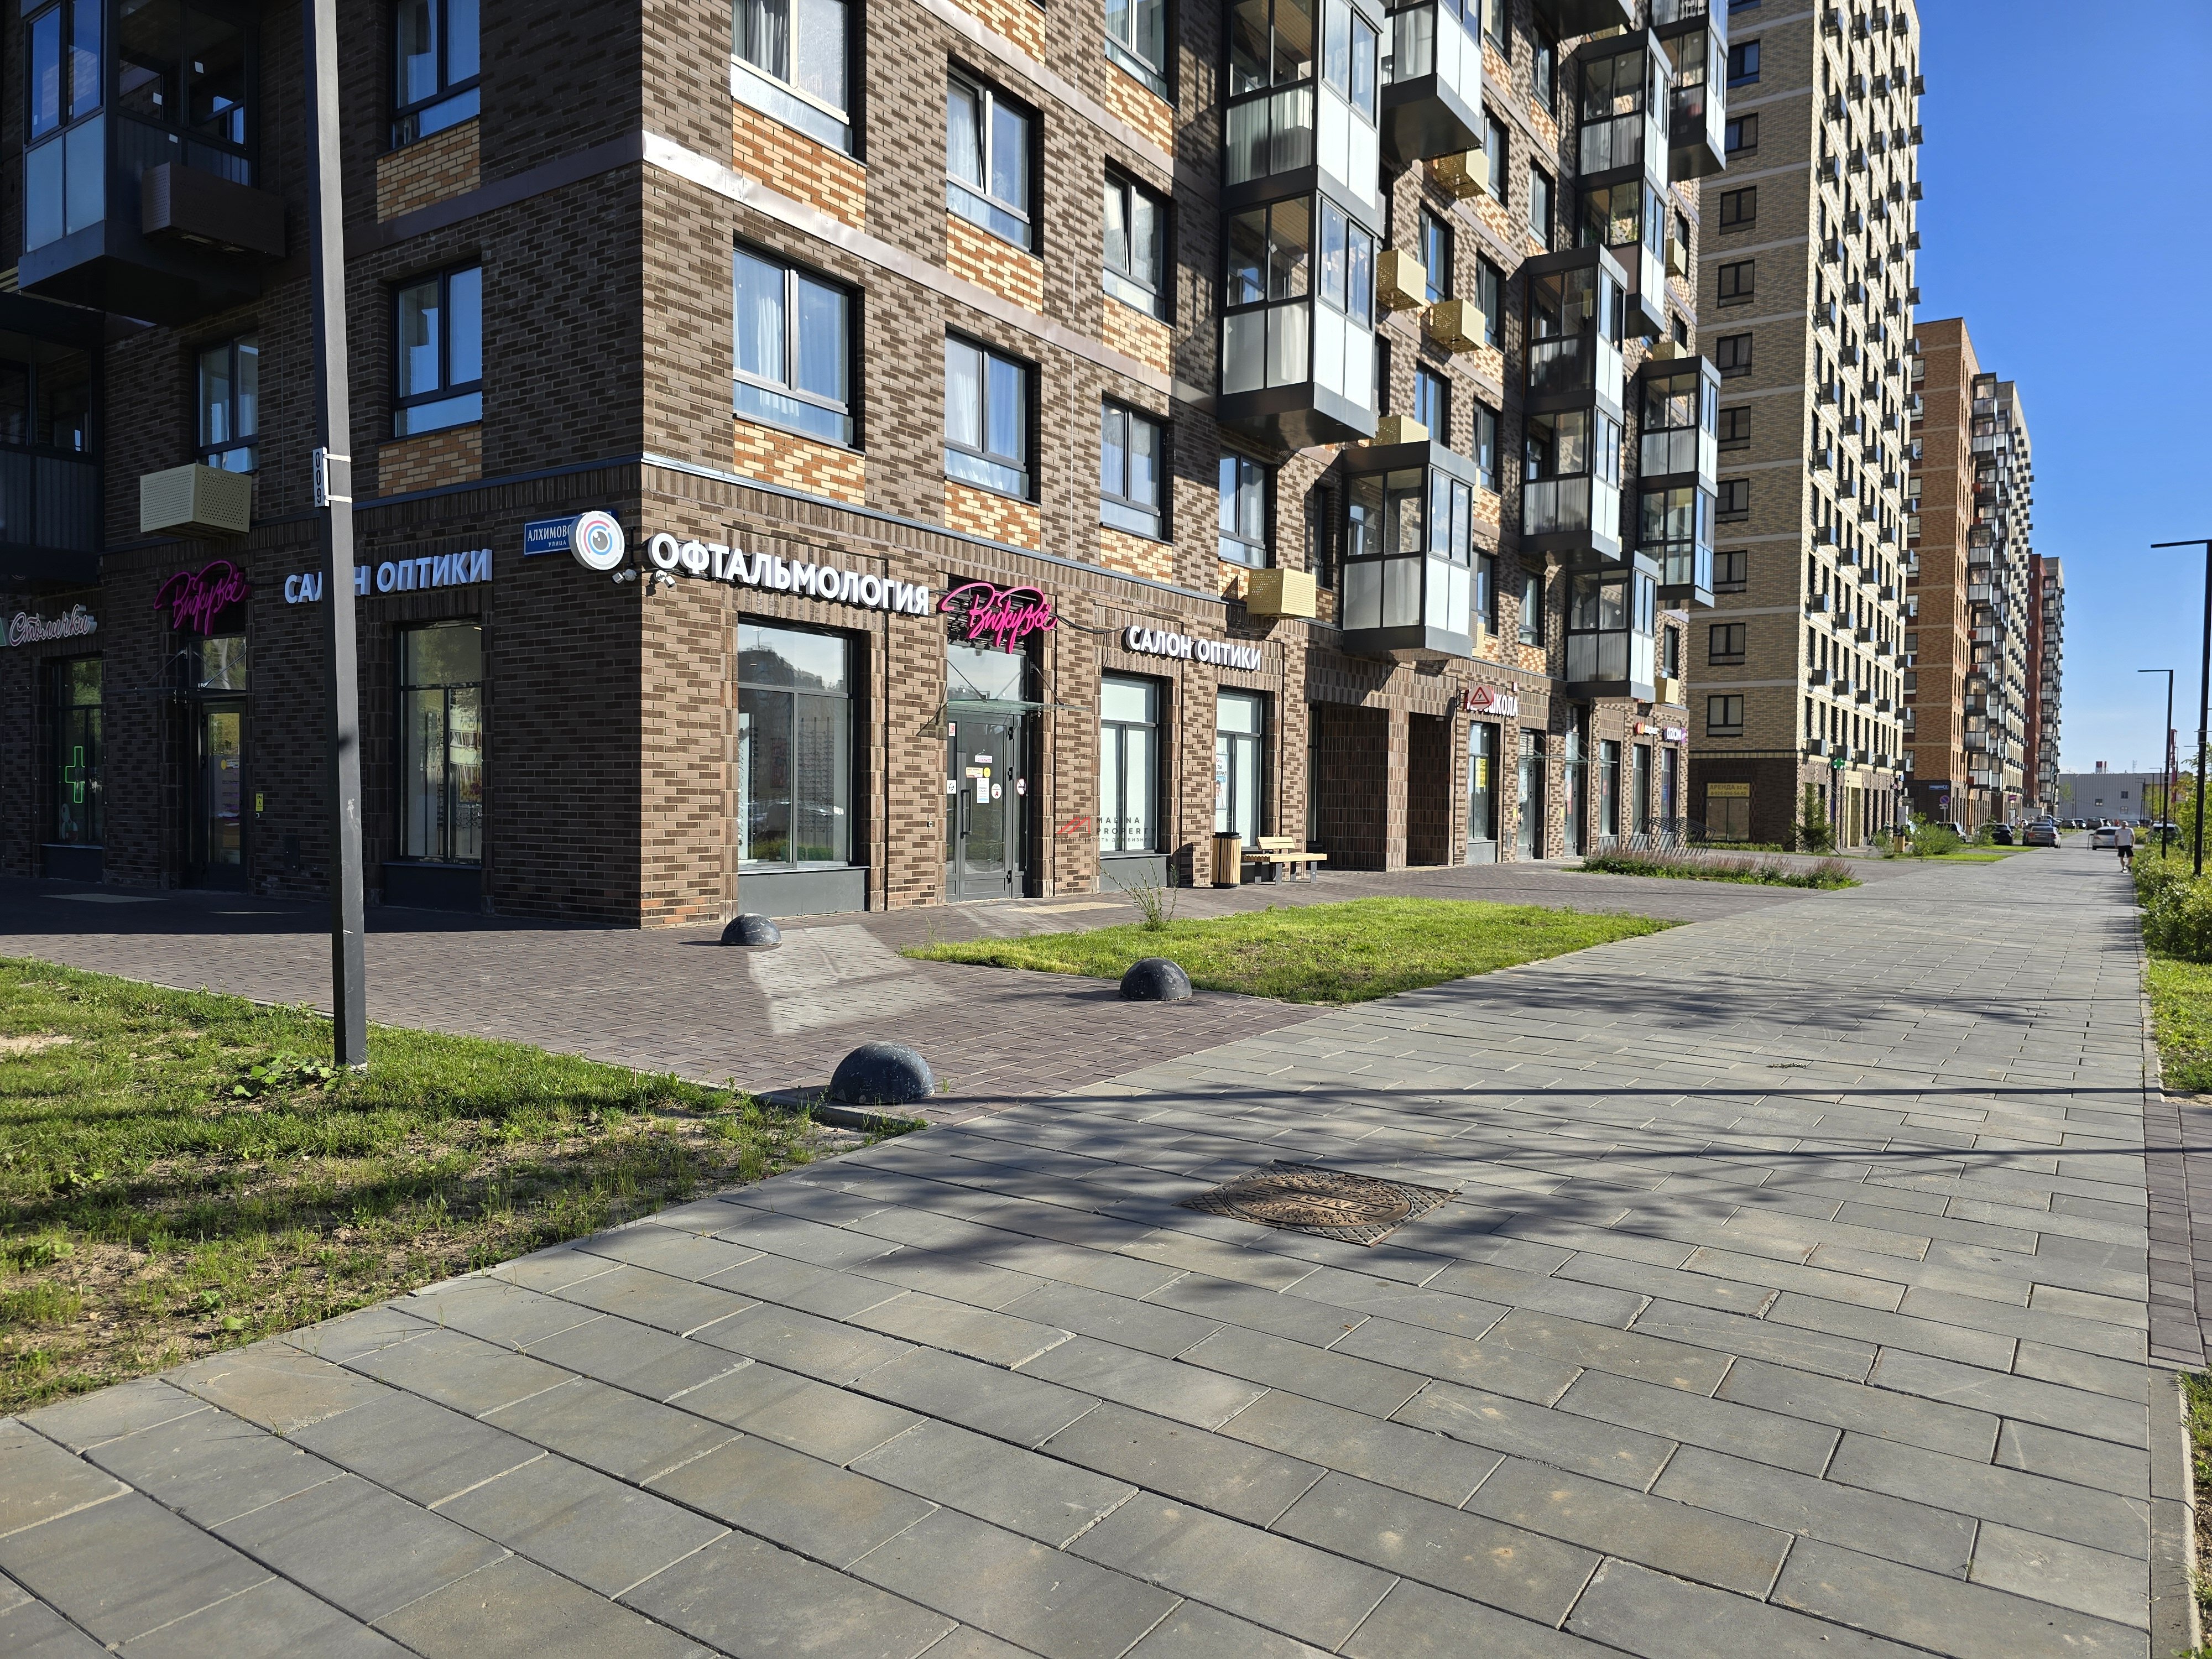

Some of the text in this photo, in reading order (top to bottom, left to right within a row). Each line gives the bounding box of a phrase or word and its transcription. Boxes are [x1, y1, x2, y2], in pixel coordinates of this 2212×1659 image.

[285, 549, 492, 604] САЛН ОПТИКИ
[648, 533, 929, 616] ОФТАЛЬМОЛОГИЯ
[9, 604, 91, 646] Столички
[1127, 625, 1261, 671] САЛОН ОПТИКИ
[1666, 727, 1682, 740] OZON
